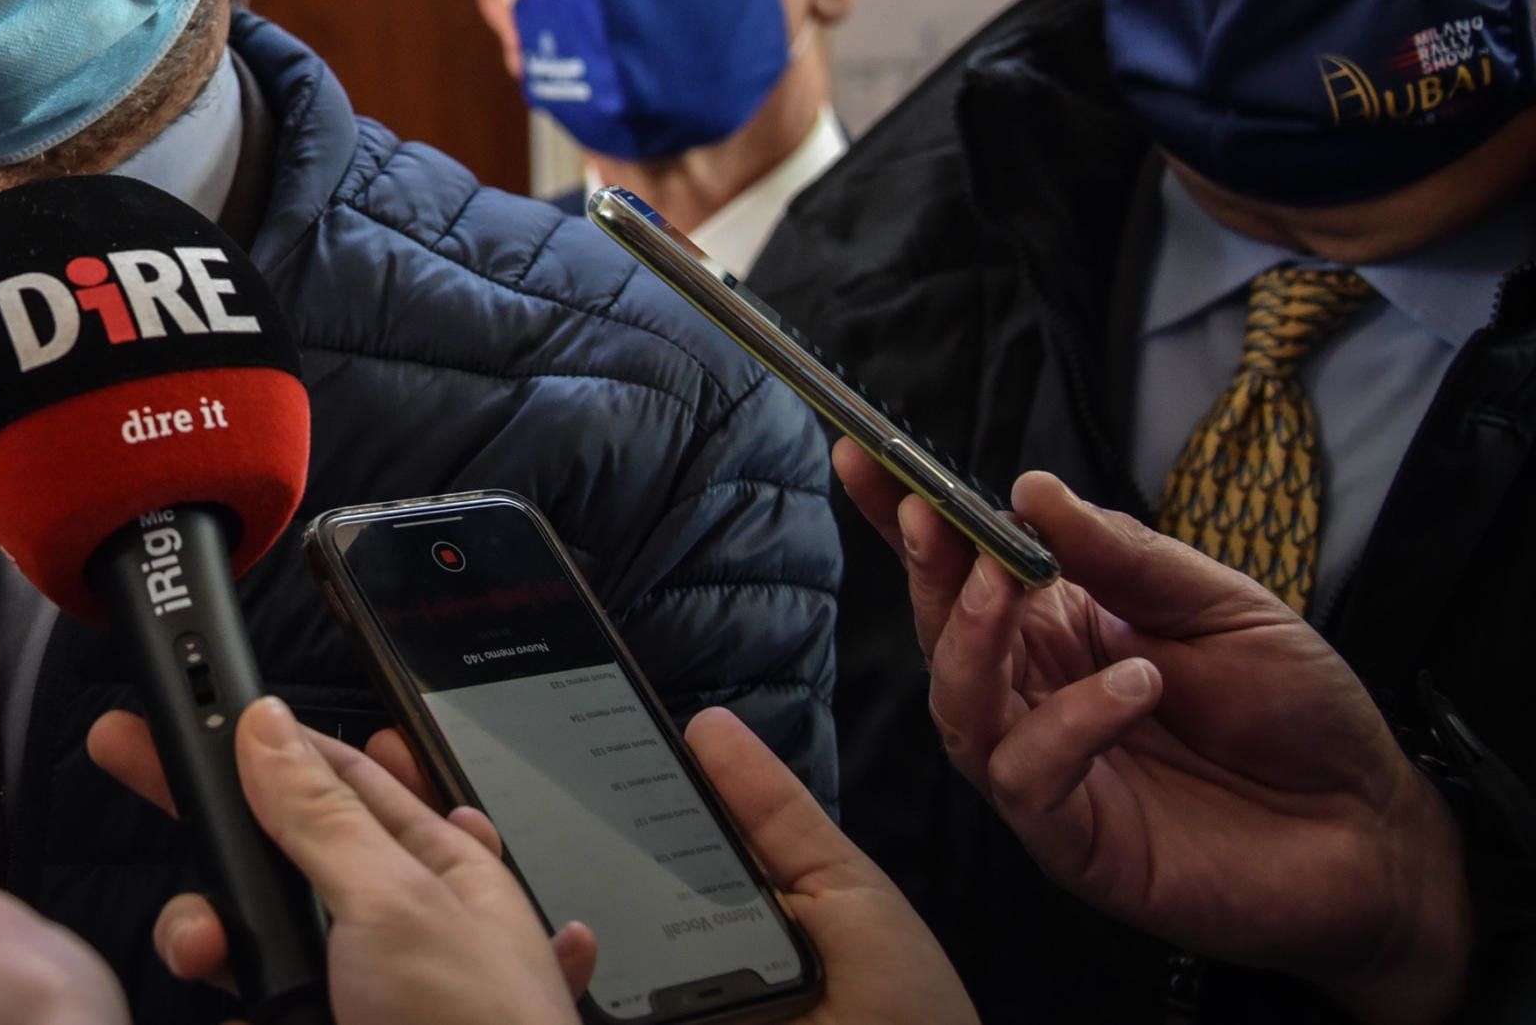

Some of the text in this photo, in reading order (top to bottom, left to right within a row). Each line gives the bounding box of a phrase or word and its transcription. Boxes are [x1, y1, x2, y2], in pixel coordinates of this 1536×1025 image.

[121, 396, 228, 444] dire it
[141, 527, 192, 616] iRig
[463, 641, 550, 665] Nuovo memo 140
[662, 905, 764, 940] Memo Vocali
